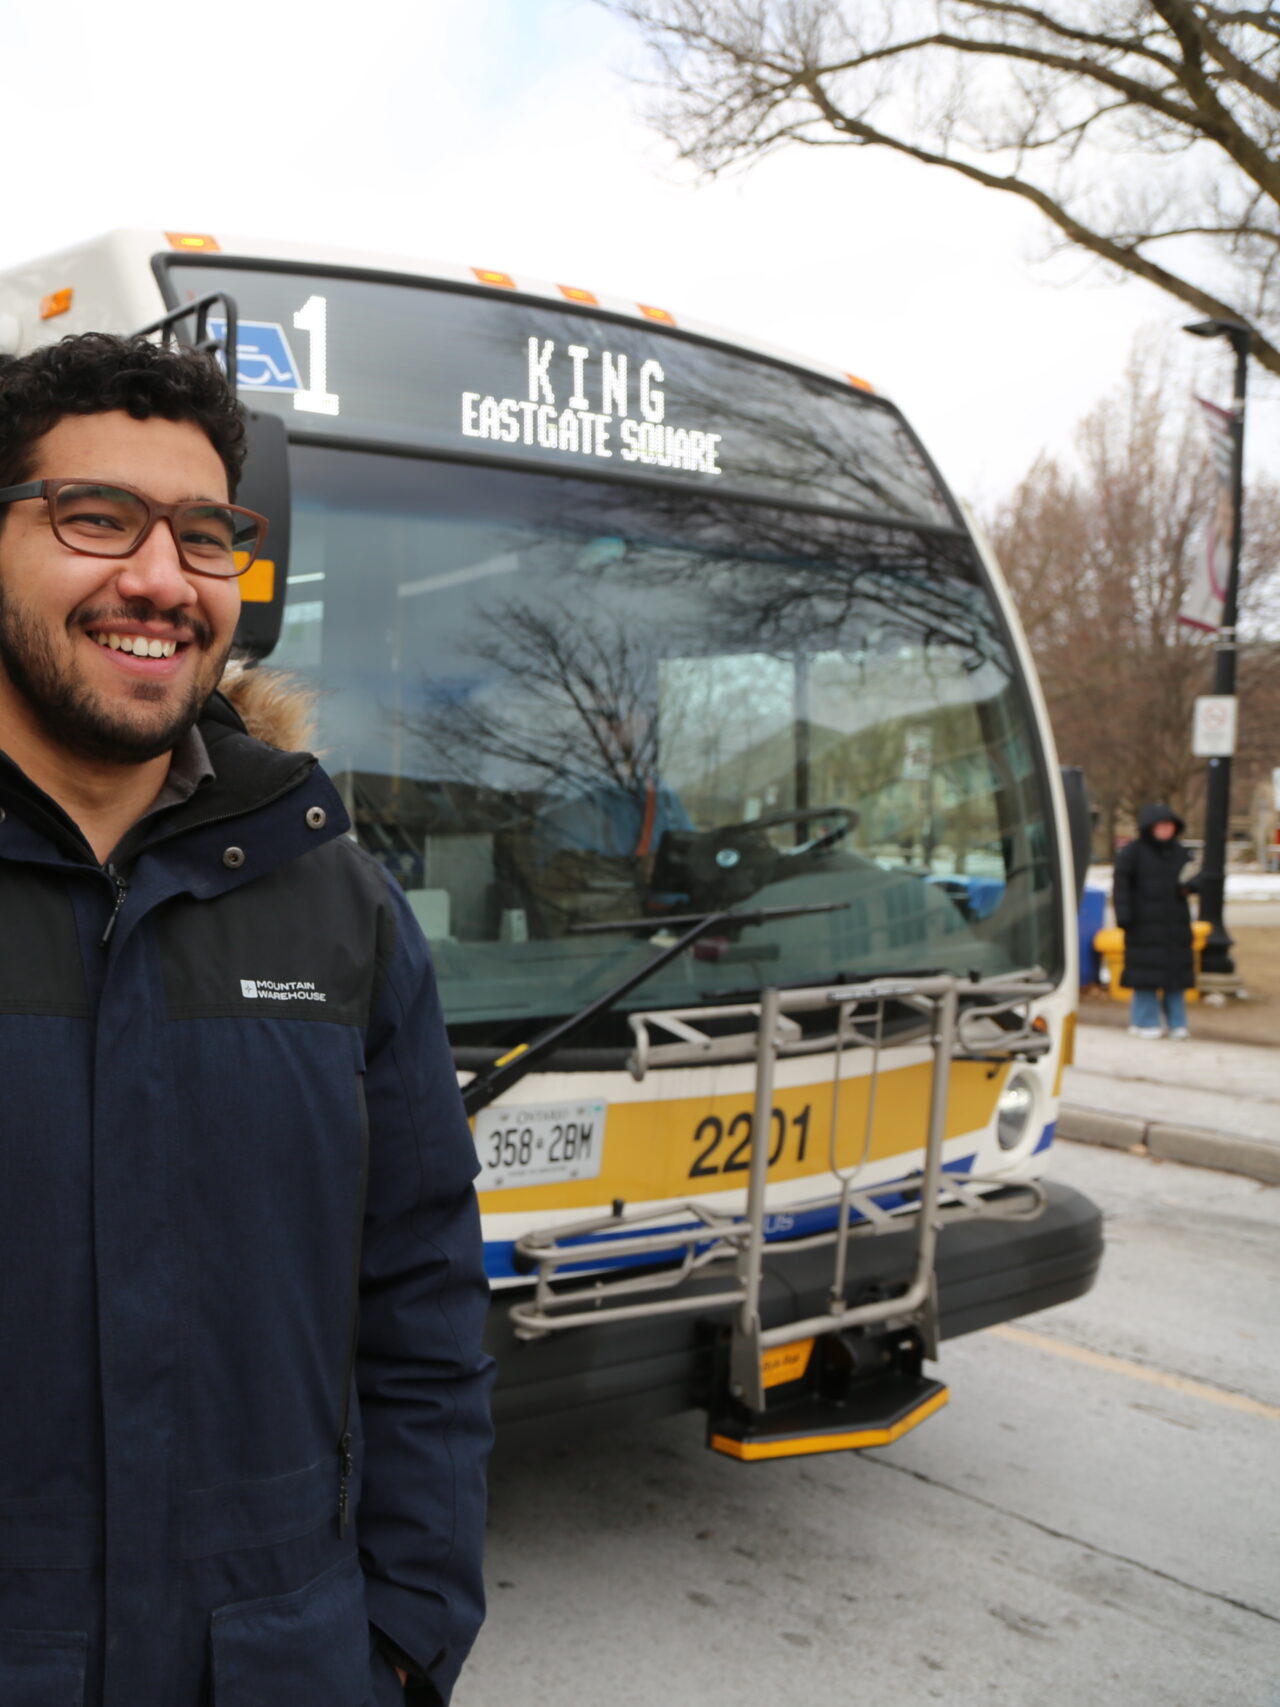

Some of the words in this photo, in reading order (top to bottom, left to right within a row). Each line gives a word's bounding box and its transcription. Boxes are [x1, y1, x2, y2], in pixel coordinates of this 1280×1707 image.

[293, 295, 340, 417] 1
[528, 336, 665, 424] KING
[461, 391, 613, 458] EASTGATE
[620, 418, 722, 475] SQUARE
[256, 980, 315, 991] MOUNTAIN
[257, 990, 327, 1002] WAREHOUSE
